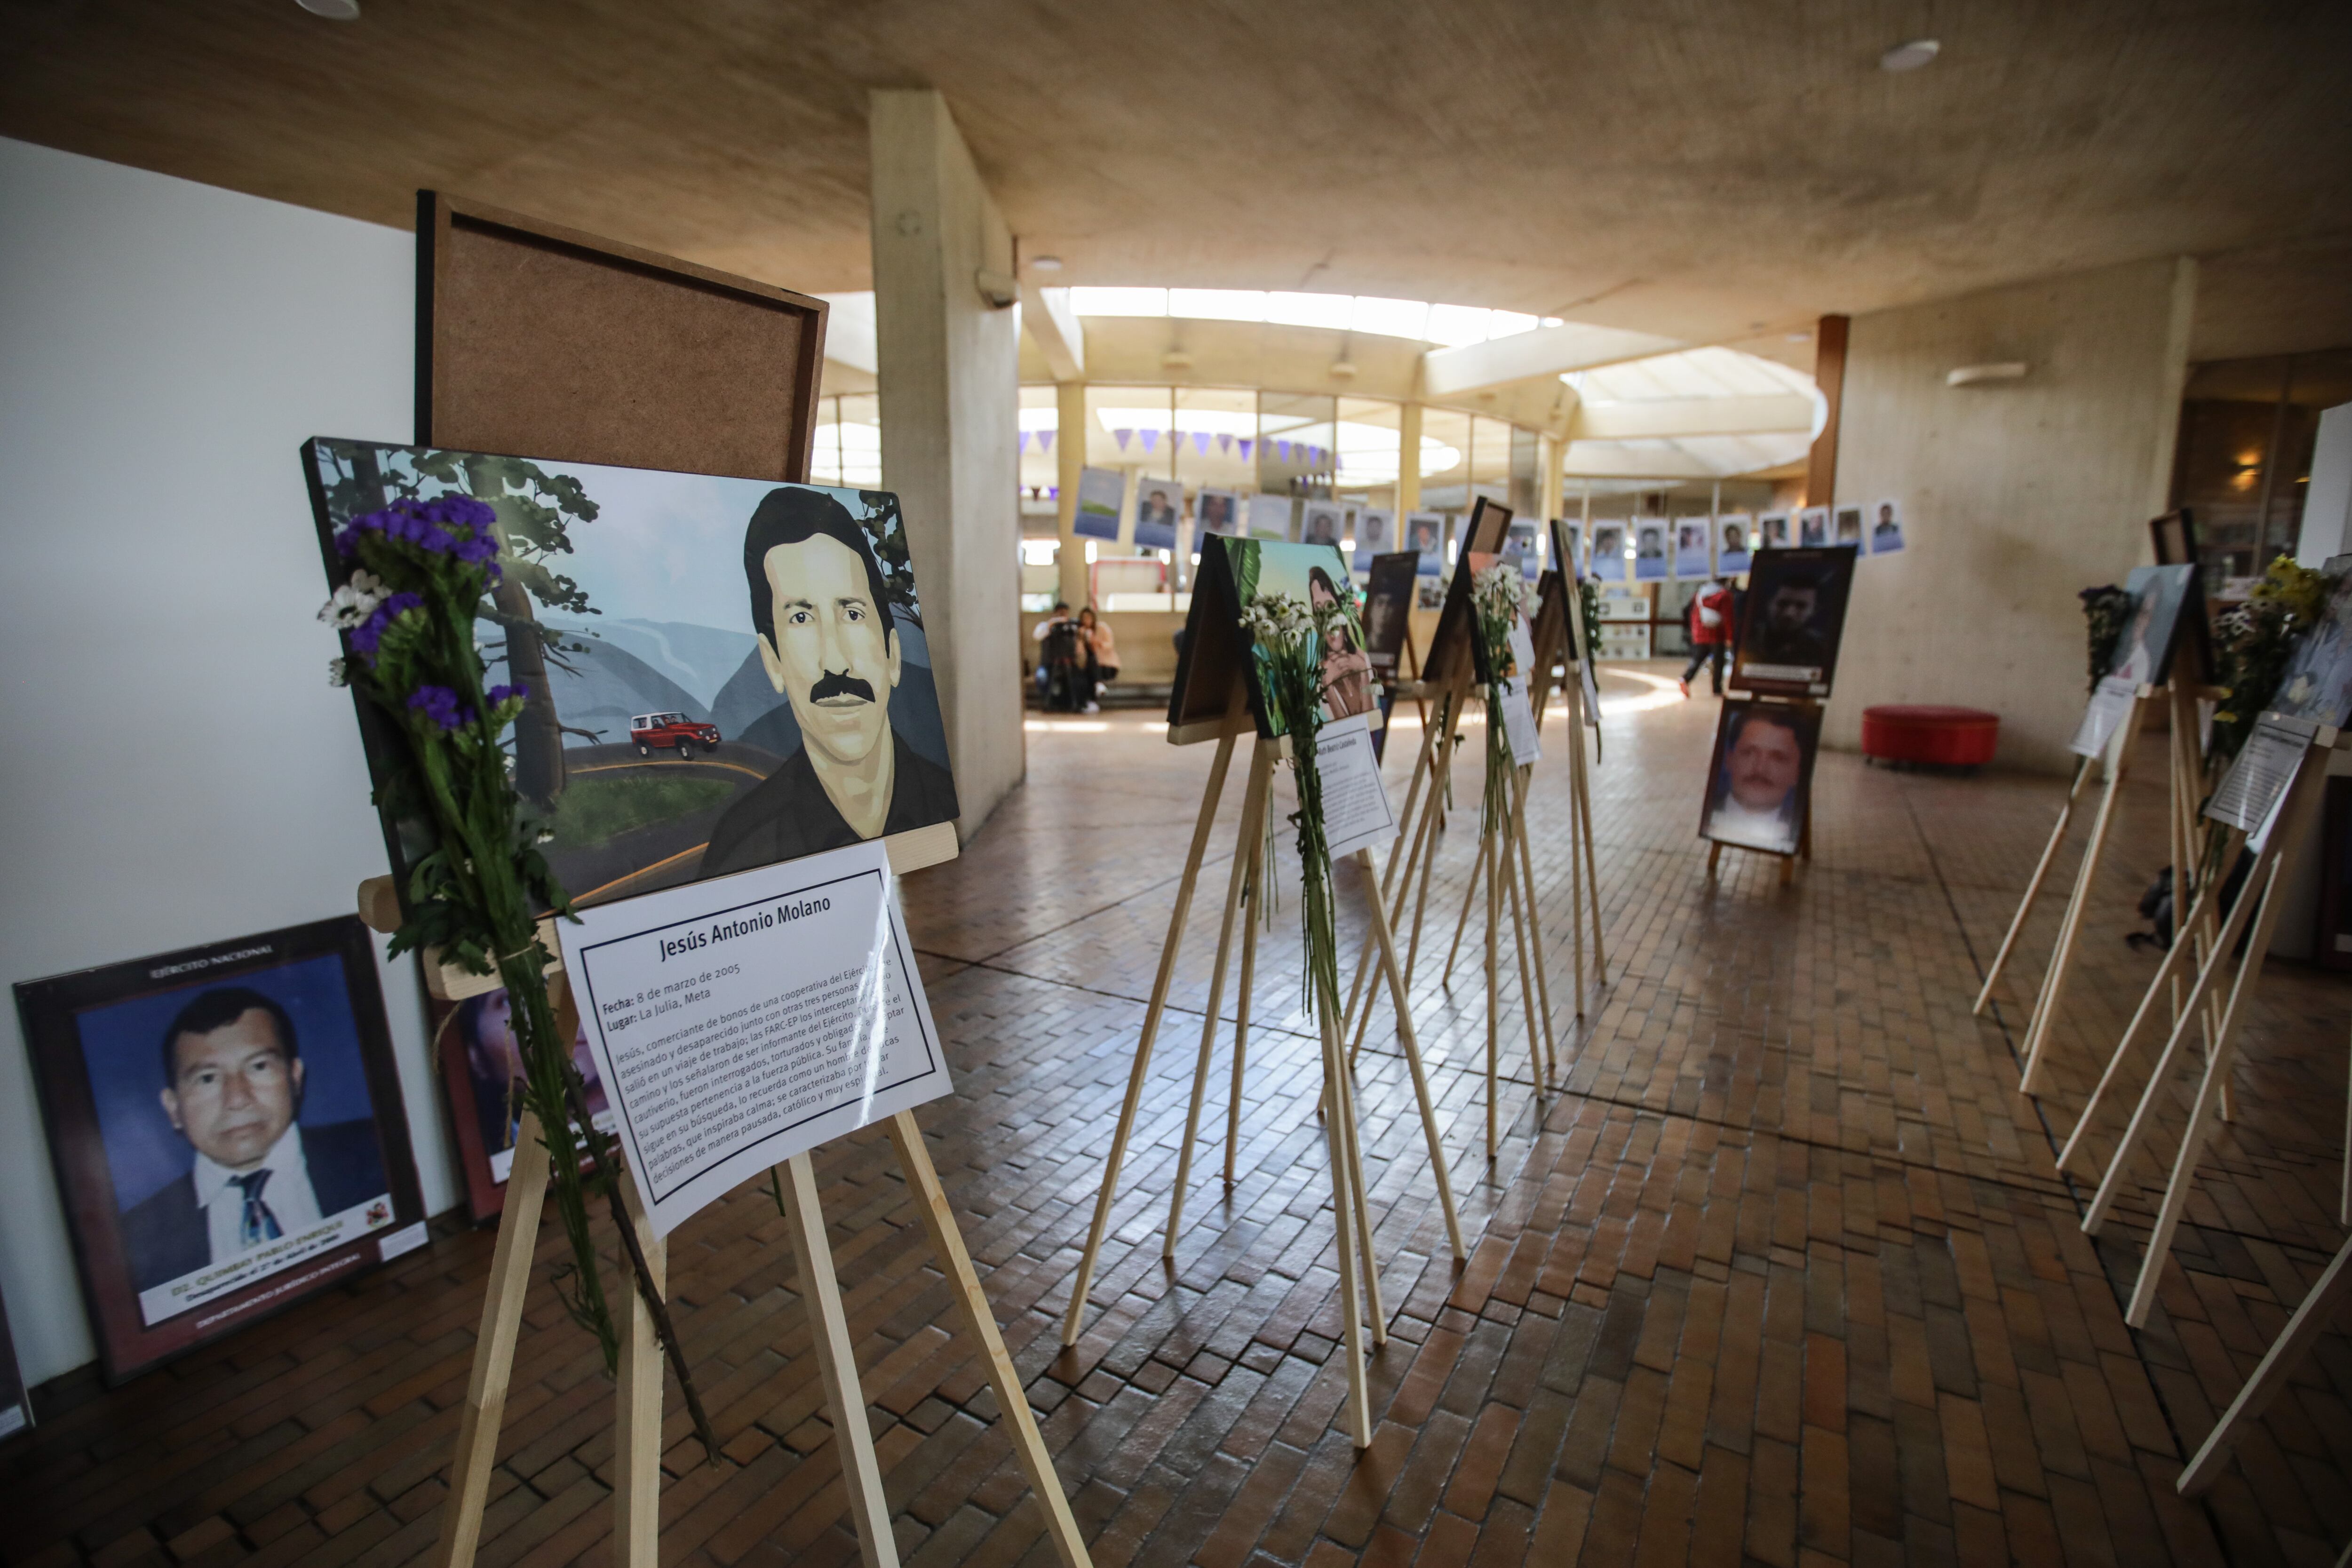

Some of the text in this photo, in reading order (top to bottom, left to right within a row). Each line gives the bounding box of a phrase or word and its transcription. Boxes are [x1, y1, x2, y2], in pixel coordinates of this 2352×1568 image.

[660, 898, 830, 963] Jesús Antonio Molano
[602, 963, 740, 1015] Fecha: 8 de marzo de 2005
[606, 989, 711, 1032] Lugar: La Julia, Meta
[616, 1047, 644, 1066] Jesús,
[646, 1024, 704, 1051] comerciante
[706, 1018, 718, 1028] de
[720, 1008, 748, 1024] bonos
[750, 1003, 761, 1013] de
[763, 997, 779, 1008] una
[781, 979, 828, 1002] cooperativa
[830, 972, 842, 984] del
[620, 1053, 667, 1079] asesinado
[669, 1050, 675, 1060] y
[677, 1026, 739, 1055] desaparecido
[740, 1017, 763, 1033] junto
[765, 1011, 780, 1021] con
[782, 1002, 803, 1015] otras
[804, 996, 820, 1007] tres
[822, 983, 859, 1003] personas
[861, 971, 891, 987] cuao
[625, 1076, 646, 1094] salió
[648, 1073, 660, 1083] en
[661, 1067, 673, 1077] un
[675, 1056, 697, 1071] viaje
[699, 1051, 711, 1061] de
[713, 1038, 748, 1056] trabajo;
[750, 1031, 763, 1042] las
[764, 1016, 798, 1036] FARC-EP
[800, 1012, 812, 1023] los
[883, 984, 890, 993] el
[629, 994, 901, 1109] camino y los señalaron de ser informante del Ejército. Durae el
[634, 1098, 679, 1124] cautiverio,
[680, 1082, 709, 1101] fueron
[710, 1059, 770, 1087] interrogados,
[771, 1040, 815, 1062] torturados
[816, 1037, 821, 1046] y
[823, 1023, 864, 1042] obligados
[873, 1007, 904, 1024] aeptar
[639, 1130, 649, 1139] su
[650, 1107, 689, 1133] supuesta
[691, 1083, 743, 1114] pertenencia
[752, 1075, 760, 1084] la
[762, 1064, 789, 1080] fuerza
[791, 1051, 825, 1071] pública.
[826, 1045, 837, 1055] Su
[644, 1137, 665, 1154] sigue
[666, 1130, 677, 1141] en
[678, 1124, 689, 1135] su
[690, 1102, 737, 1128] búsqueda,
[738, 1096, 747, 1105] lo
[749, 1079, 787, 1100] recuerda
[789, 1069, 812, 1083] como
[814, 1064, 825, 1073] un
[861, 1046, 871, 1055] de
[878, 1035, 899, 1050] ocas
[648, 1051, 890, 1171] palabras, que inspiraba calma; se caracterizaba por toar
[653, 1066, 889, 1184] decisiones de manera pausada, católico y muy espirual.
